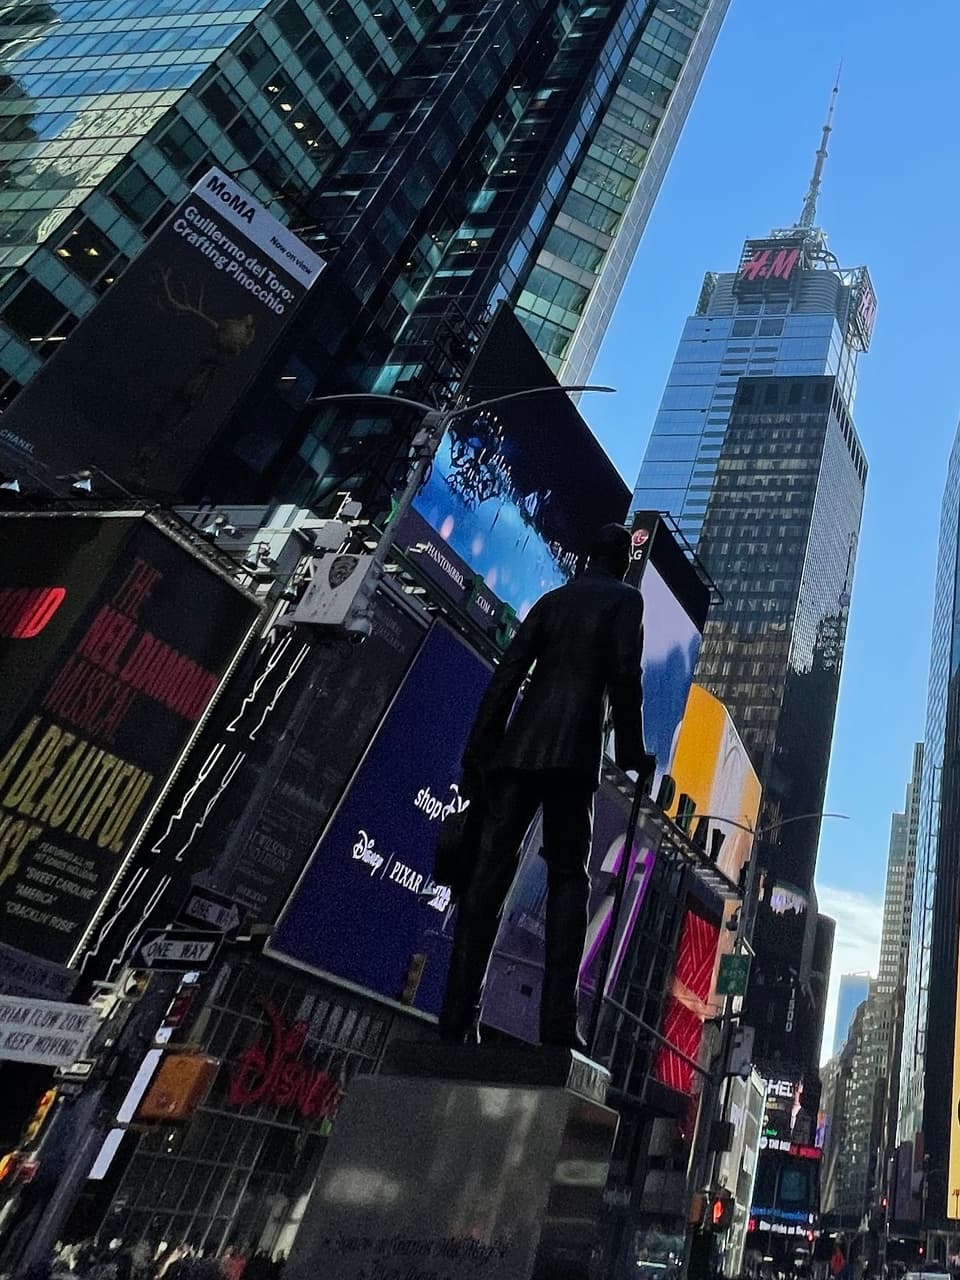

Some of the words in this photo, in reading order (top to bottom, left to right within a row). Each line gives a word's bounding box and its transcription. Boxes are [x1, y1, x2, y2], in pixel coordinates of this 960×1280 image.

[205, 175, 257, 225] MoMA
[172, 218, 229, 271] Crafting
[225, 260, 286, 316] Pinocchio
[184, 205, 246, 261] Guillermo
[245, 257, 268, 279] del
[264, 270, 296, 303] Toro:
[270, 235, 287, 254] Now
[286, 251, 296, 262] on
[296, 259, 313, 275] view
[741, 248, 800, 280] H&M
[3, 724, 154, 853] BEAUTIFUL
[389, 861, 423, 894] PIXAR
[147, 942, 173, 957] ONE
[180, 943, 208, 959] WAY
[4, 1032, 34, 1051] KEEP
